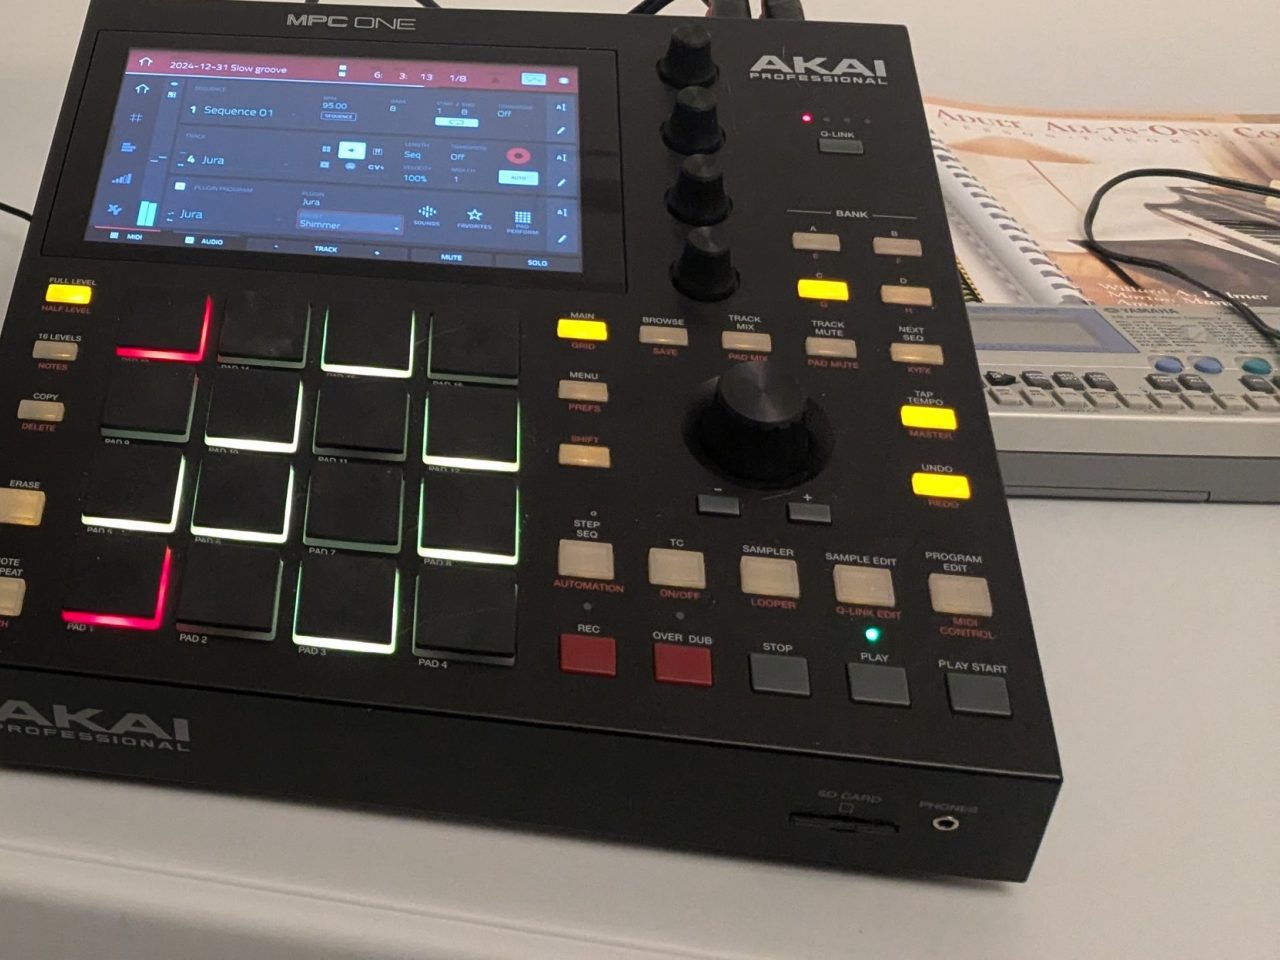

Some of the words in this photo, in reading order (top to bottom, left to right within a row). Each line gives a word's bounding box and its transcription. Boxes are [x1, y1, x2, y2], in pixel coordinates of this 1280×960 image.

[286, 13, 349, 30] MPC
[353, 15, 417, 32] ONE
[169, 61, 228, 72] 2024-12-31
[230, 63, 254, 73] Slow
[255, 66, 287, 75] groove
[749, 54, 887, 77] AKAI
[420, 73, 433, 81] 13
[450, 74, 467, 83] 1/8
[749, 72, 888, 85] PROFESSIONAL
[322, 102, 348, 110] 95.00
[190, 105, 197, 114] 1
[203, 105, 257, 119] Sequence
[258, 108, 274, 117] 01
[497, 110, 512, 118] Off
[820, 131, 855, 139] Q-LINK
[186, 155, 195, 163] 4
[201, 155, 225, 165] Jura
[403, 151, 422, 160] Seq
[450, 153, 465, 161] Off
[403, 174, 428, 183] 100%
[302, 198, 320, 207] Jura
[179, 209, 203, 220] Jura
[835, 209, 869, 219] BANK
[299, 219, 341, 230] Shimmer
[126, 233, 143, 241] MIDI
[201, 238, 224, 246] AUDIO
[314, 245, 338, 253] TRACK
[441, 253, 463, 262] MUTE
[527, 259, 548, 267] SOLO
[49, 277, 69, 285] FULL
[71, 278, 97, 286] LEVEL
[41, 304, 64, 312] HALF
[66, 306, 92, 314] LEVEL
[570, 312, 595, 320] MAIN
[642, 316, 685, 326] BROWSE
[728, 314, 762, 323] TRACK
[736, 323, 755, 331] MIX
[811, 320, 845, 329] TRACK
[815, 328, 844, 337] MUTE
[898, 326, 925, 334] NEXT
[38, 332, 48, 340] 16
[49, 333, 82, 342] LEVELS
[903, 334, 925, 342] SEQ
[571, 342, 596, 350] GRID
[652, 348, 678, 357] SAVE
[728, 353, 748, 361] PAD
[750, 354, 769, 362] MIX
[38, 362, 68, 371] NOTES
[807, 359, 829, 367] PAD
[830, 360, 859, 369] MUTE
[569, 371, 599, 380] MENU
[33, 392, 59, 401] COPY
[915, 390, 934, 398] TAP
[906, 397, 944, 406] TEMPO
[568, 404, 602, 412] PREFS
[21, 422, 56, 432] DELETE
[908, 429, 953, 439] MASTER
[921, 464, 953, 473] UNDO
[9, 479, 41, 489] ERASE
[928, 499, 960, 509] REDO
[573, 519, 601, 529] STEP
[576, 529, 598, 539] SEQ
[670, 538, 684, 548] TC
[309, 547, 329, 555] PAD
[742, 544, 794, 557] SAMPLER
[825, 552, 870, 564] SAMPLE
[872, 556, 897, 566] EDIT
[925, 551, 983, 564] PROGRAM
[943, 562, 968, 573] EDIT
[553, 579, 624, 593] AUTOMATION
[659, 589, 701, 600] ON/OFF
[750, 598, 796, 610] LOOPER
[836, 606, 875, 617] Q-LINK
[877, 609, 902, 620] EDIT
[952, 616, 978, 627] MIDI
[67, 623, 86, 632] PAD
[577, 624, 600, 634] REC
[652, 631, 683, 642] OVER
[688, 635, 713, 645] DUB
[939, 626, 995, 640] CONTROL
[179, 633, 200, 643] PAD
[200, 636, 208, 644] 2
[298, 645, 319, 655] PAD
[319, 648, 327, 656] 3
[762, 642, 793, 653] STOP
[860, 652, 889, 663] PLAY
[418, 658, 439, 668] PAD
[440, 660, 448, 669] 4
[938, 659, 969, 671] PLAY
[972, 662, 1008, 674] START
[840, 791, 883, 804] CARD
